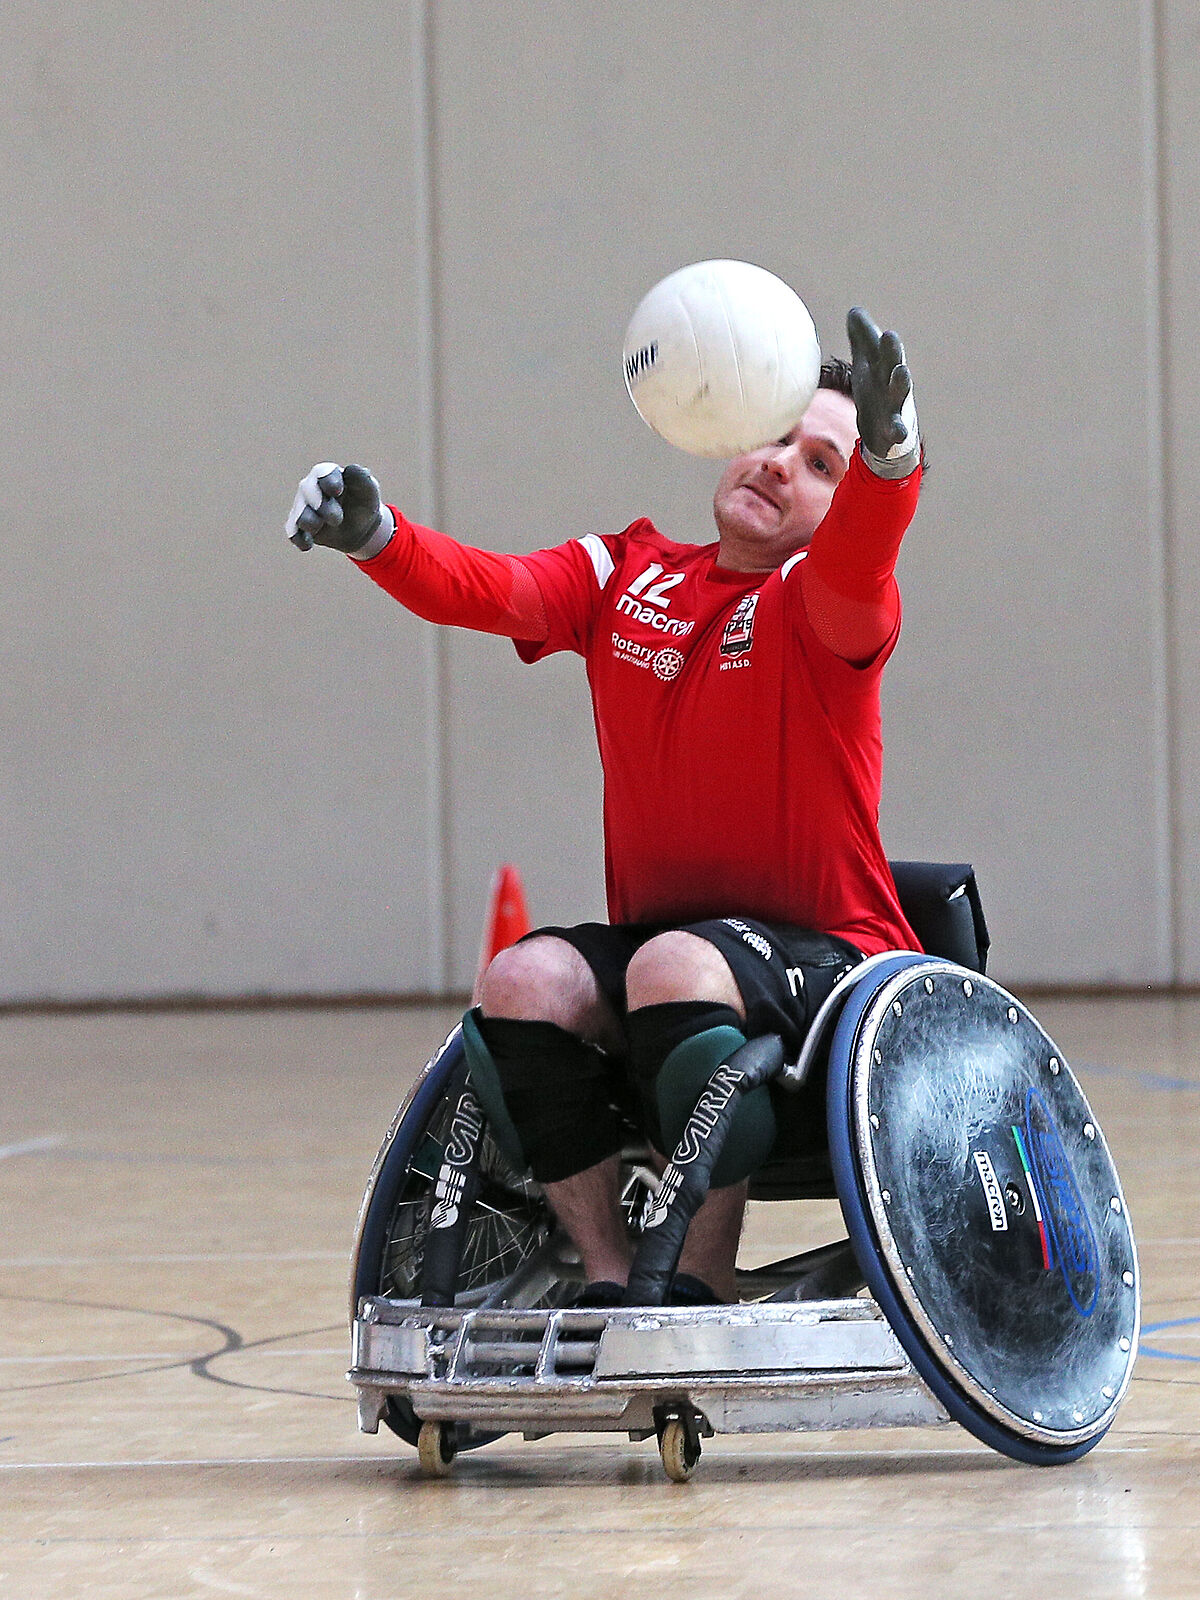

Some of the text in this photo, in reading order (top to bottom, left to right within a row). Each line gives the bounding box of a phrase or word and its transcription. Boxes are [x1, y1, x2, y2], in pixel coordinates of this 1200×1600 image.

[626, 562, 686, 609] 12
[615, 594, 695, 637] macron
[611, 632, 656, 662] Rotary
[977, 1152, 1006, 1230] macron
